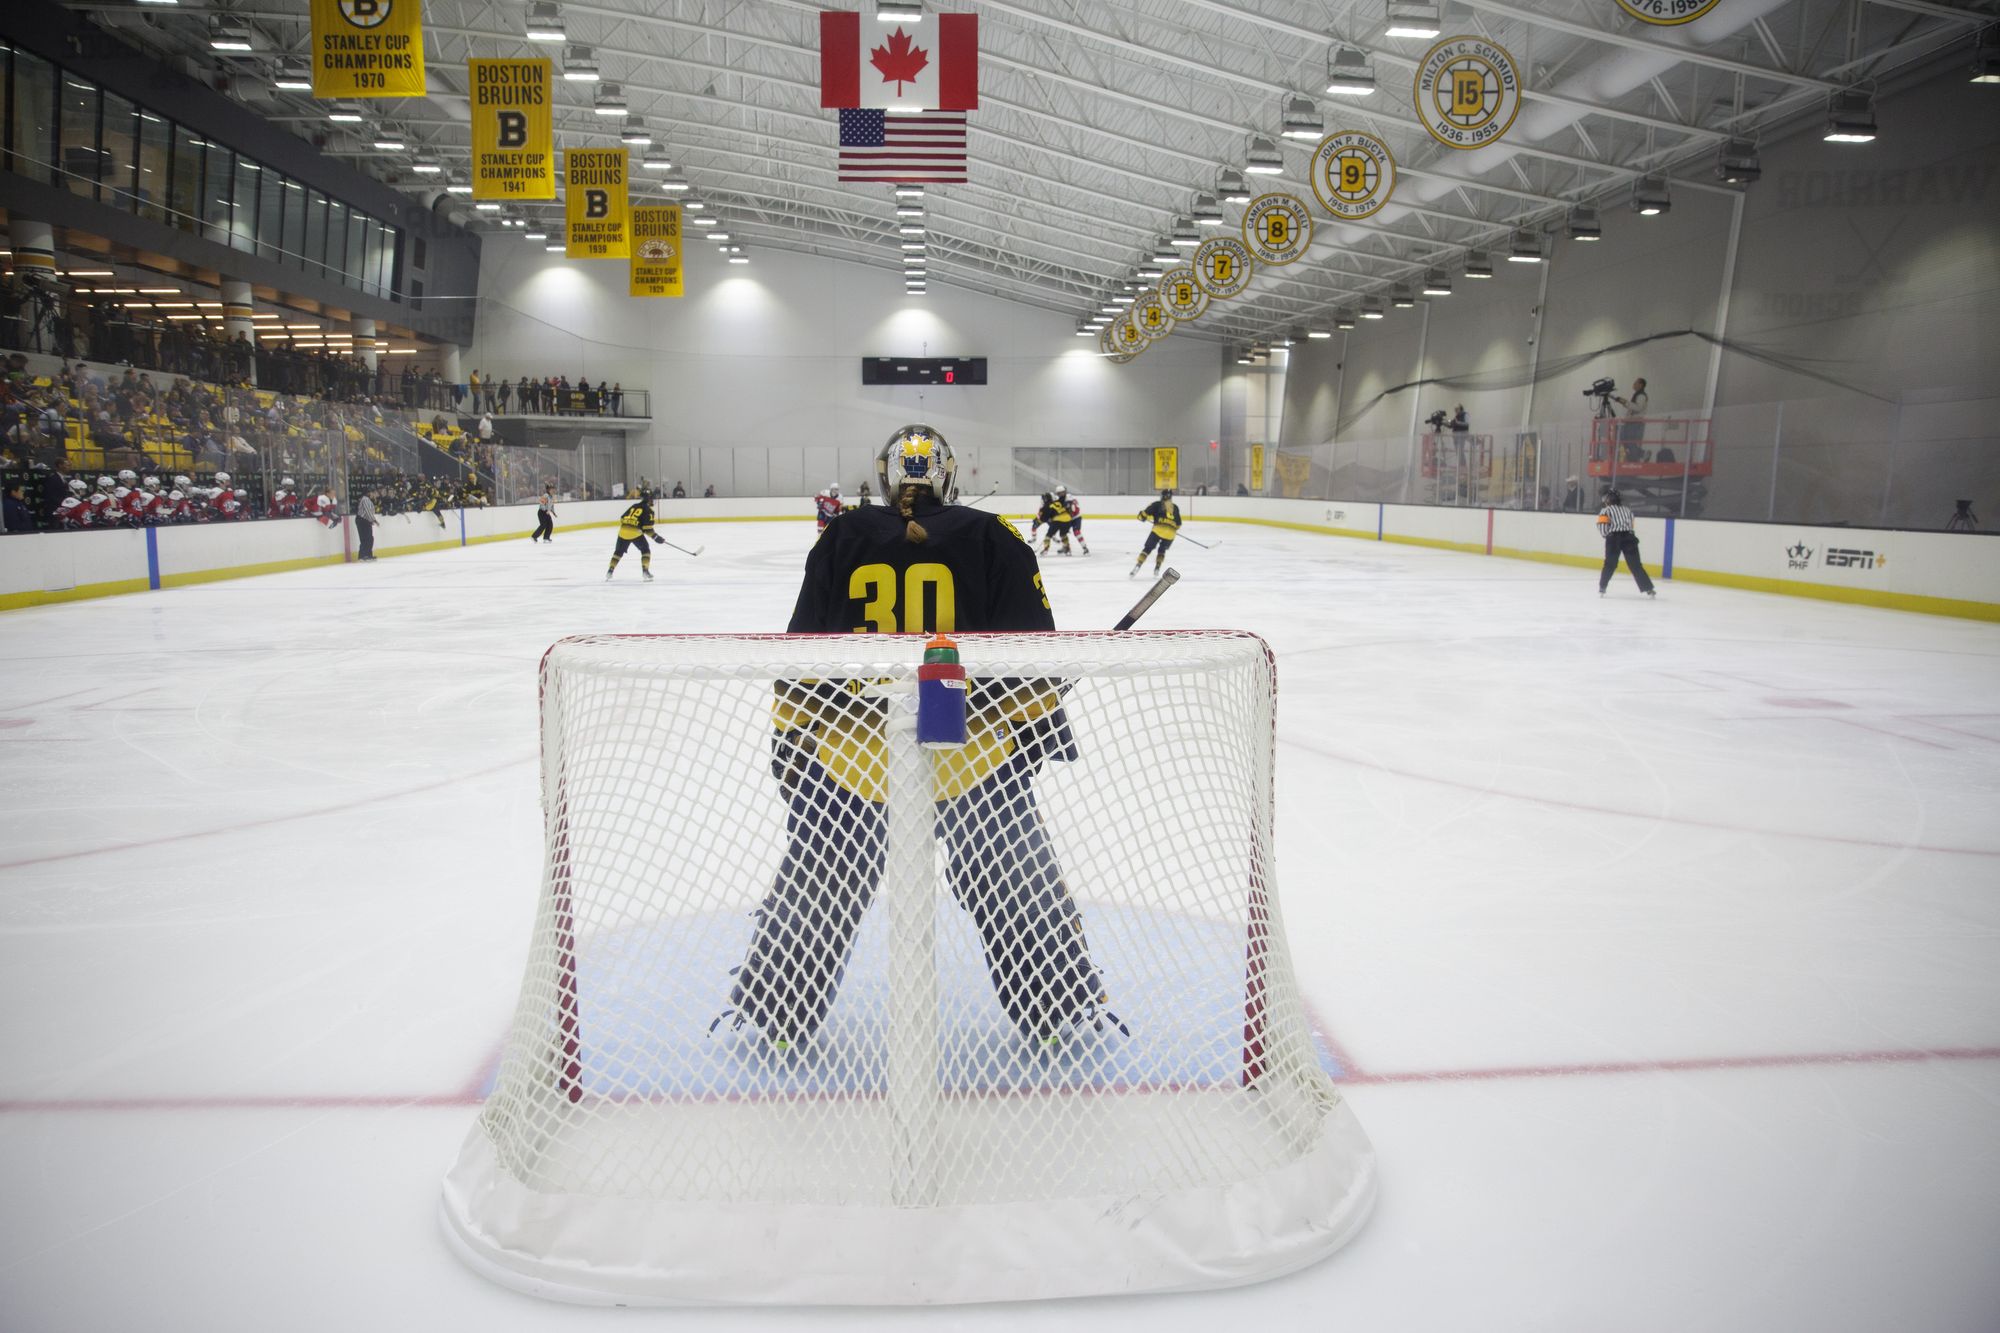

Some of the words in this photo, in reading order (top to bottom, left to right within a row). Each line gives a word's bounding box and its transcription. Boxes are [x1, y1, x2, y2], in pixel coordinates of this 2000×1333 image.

[324, 34, 381, 50] STANLEY
[385, 34, 410, 50] CUP
[324, 53, 412, 69] CHAMPIONS
[1421, 47, 1454, 91] MILTON
[1474, 43, 1515, 92] SCHMIDT
[353, 73, 385, 88] 1970
[477, 64, 543, 83] BOSTON
[478, 85, 543, 105] BRUINS
[1458, 80, 1478, 105] 15
[497, 110, 528, 149] B
[1320, 139, 1343, 161] JOHN
[1357, 137, 1388, 164] BUCYK
[481, 154, 523, 165] STANLEY
[526, 154, 545, 165] CUP
[570, 153, 622, 168] BOSTON
[480, 168, 546, 179] CHAMPIONS
[570, 169, 622, 185] BRUINS
[1345, 165, 1360, 185] 9
[502, 182, 526, 193] 1941
[585, 188, 609, 219] B
[634, 210, 677, 223] BOSTON
[1247, 198, 1279, 230] CAMERON
[1292, 204, 1309, 230] NEELY
[572, 223, 605, 233] STANLEY
[607, 223, 622, 232] CUP
[634, 223, 677, 237] BRUINS
[1271, 221, 1284, 238] 8
[572, 233, 623, 243] CHAMPIONS
[1217, 260, 1228, 274] 7
[1180, 288, 1189, 301] 5
[1149, 311, 1158, 322] 4
[1788, 559, 1808, 570] PHF
[848, 562, 956, 633] 30
